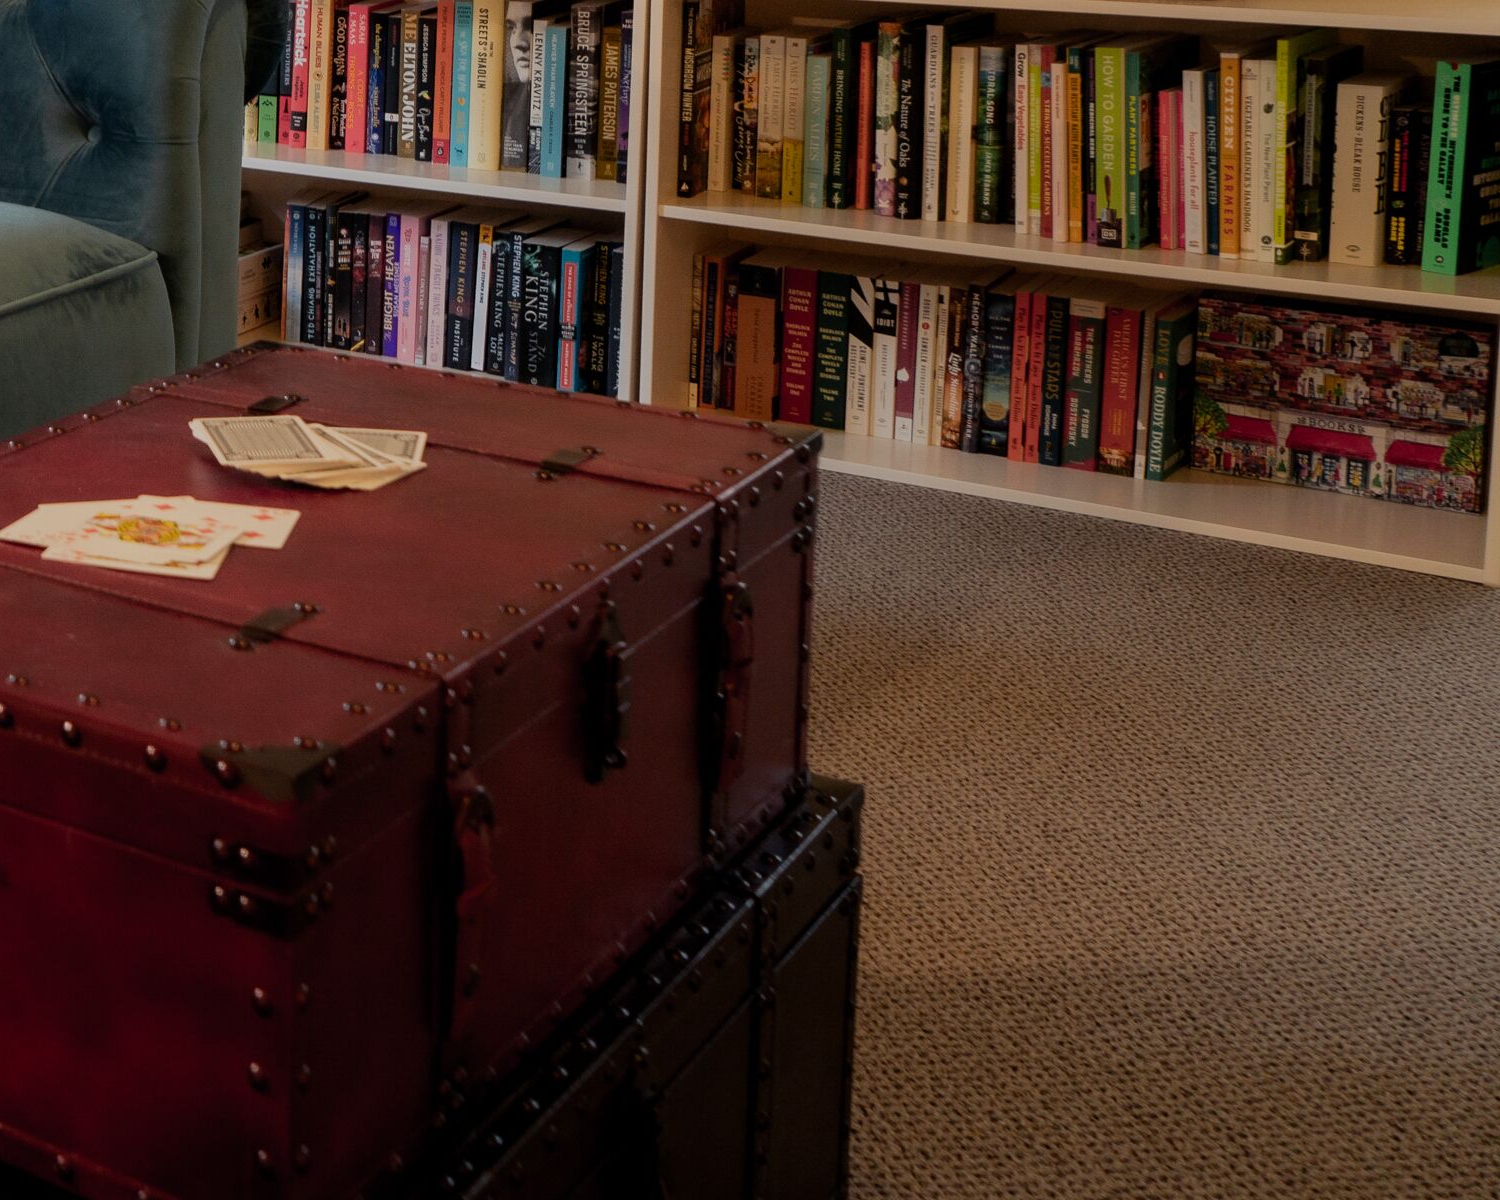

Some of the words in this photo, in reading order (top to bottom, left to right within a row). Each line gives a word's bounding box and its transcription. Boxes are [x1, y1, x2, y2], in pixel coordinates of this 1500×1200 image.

[404, 13, 417, 40] ME
[478, 8, 489, 46] STREETS
[577, 10, 590, 51] BRUCE
[372, 34, 381, 69] changeling
[534, 33, 543, 66] LENNY
[604, 42, 618, 79] JAMES
[928, 35, 938, 90] GUARDIANS
[1016, 52, 1026, 78] Grow
[402, 42, 416, 94] ELTON
[477, 52, 487, 89] SHAOLIN
[683, 48, 694, 90] MUSHROOM
[771, 56, 781, 80] JAMES
[789, 53, 800, 85] JAMES
[1103, 55, 1114, 88] HOW
[532, 69, 543, 110] KRAVITZ
[574, 55, 589, 135] SPRINGSTEEN
[770, 82, 780, 126] HERRIOT
[810, 64, 822, 114] GARDEN
[835, 69, 844, 113] BRINGING
[901, 79, 911, 94] The
[1016, 84, 1026, 104] Easy
[1103, 94, 1113, 111] TO
[1442, 88, 1451, 114] GUIDE
[401, 95, 414, 142] JOHN
[602, 82, 616, 140] PATTERSON
[682, 92, 694, 121] HUNTER
[788, 87, 798, 132] HERRIOT
[899, 95, 911, 129] Nature
[928, 104, 937, 134] TREES
[1224, 76, 1234, 150] CITIZEN
[1244, 96, 1252, 139] VEGETABLE
[1355, 95, 1365, 131] DICKENS
[1441, 117, 1449, 129] TO
[809, 122, 820, 161] ALLIES
[834, 114, 843, 149] NATURE
[898, 130, 910, 140] of
[1015, 105, 1026, 151] Vegetables
[1102, 114, 1113, 171] GARDEN
[1207, 116, 1216, 153] HOUSE
[1440, 131, 1449, 148] THE
[833, 151, 842, 176] HOME
[899, 142, 910, 168] Oaks
[984, 151, 992, 173] JAMES
[1187, 131, 1198, 183] houseplants
[1243, 140, 1252, 189] GARDENER'S
[1354, 137, 1363, 166] BLEAK
[1419, 134, 1430, 172] ASIMOV
[1437, 150, 1448, 185] GALAXY
[982, 174, 991, 206] REBANKS
[1187, 185, 1198, 196] for
[1207, 156, 1216, 205] PLANTED
[1352, 166, 1362, 193] HOUSE
[1189, 197, 1198, 210] all
[1223, 164, 1234, 235] FARMERS
[1243, 190, 1252, 233] HANDBOOK
[1397, 216, 1405, 250] DOUGLAS
[1434, 211, 1442, 243] ADAMS
[1441, 208, 1451, 249] DOUGLAS
[308, 225, 316, 282] EXHALATION
[385, 235, 395, 280] HEAVEN
[458, 230, 468, 273] STEPHEN
[513, 234, 522, 274] STEPHEN
[599, 244, 608, 282] STEPHEN
[457, 277, 467, 304] KING
[495, 250, 506, 297] STEPHEN
[511, 275, 521, 298] KING
[383, 289, 393, 330] BRIGHT
[524, 275, 538, 323] KING
[538, 269, 549, 331] STEPHEN
[598, 284, 607, 305] KING
[788, 289, 811, 297] ARTHUR
[788, 296, 810, 305] CONAN
[822, 293, 847, 302] ARTHUR
[822, 301, 844, 310] CONAN
[494, 300, 503, 328] KING
[724, 304, 732, 337] ASIMOV
[876, 317, 895, 328] IDIOT
[969, 292, 981, 333] MEMORY
[1049, 310, 1062, 342] PULL
[452, 320, 460, 362] INSTITUTE
[527, 331, 538, 373] STAND
[968, 335, 979, 359] WALL
[1085, 327, 1095, 343] THE
[1119, 319, 1132, 369] AMERICA'S
[1156, 329, 1171, 365] LOVE
[858, 345, 867, 364] CRIME
[948, 352, 962, 377] Lady
[1072, 331, 1082, 377] KARAMAZOV
[1083, 344, 1095, 384] BROTHERS
[1110, 330, 1121, 384] DAUGHTER
[857, 374, 865, 412] PUNISHMENT
[1013, 376, 1024, 395] Joan
[1030, 384, 1041, 402] Joan
[1045, 361, 1059, 400] STARS
[1117, 372, 1128, 401] FIRST
[947, 377, 961, 421] Sunshine
[1011, 396, 1022, 424] Didion
[1028, 402, 1040, 430] Didion
[1151, 385, 1167, 430] RODDY
[1068, 397, 1079, 447] DOSTOEVSKY
[1080, 408, 1090, 439] FYODOR
[1148, 431, 1164, 473] DOYLE
